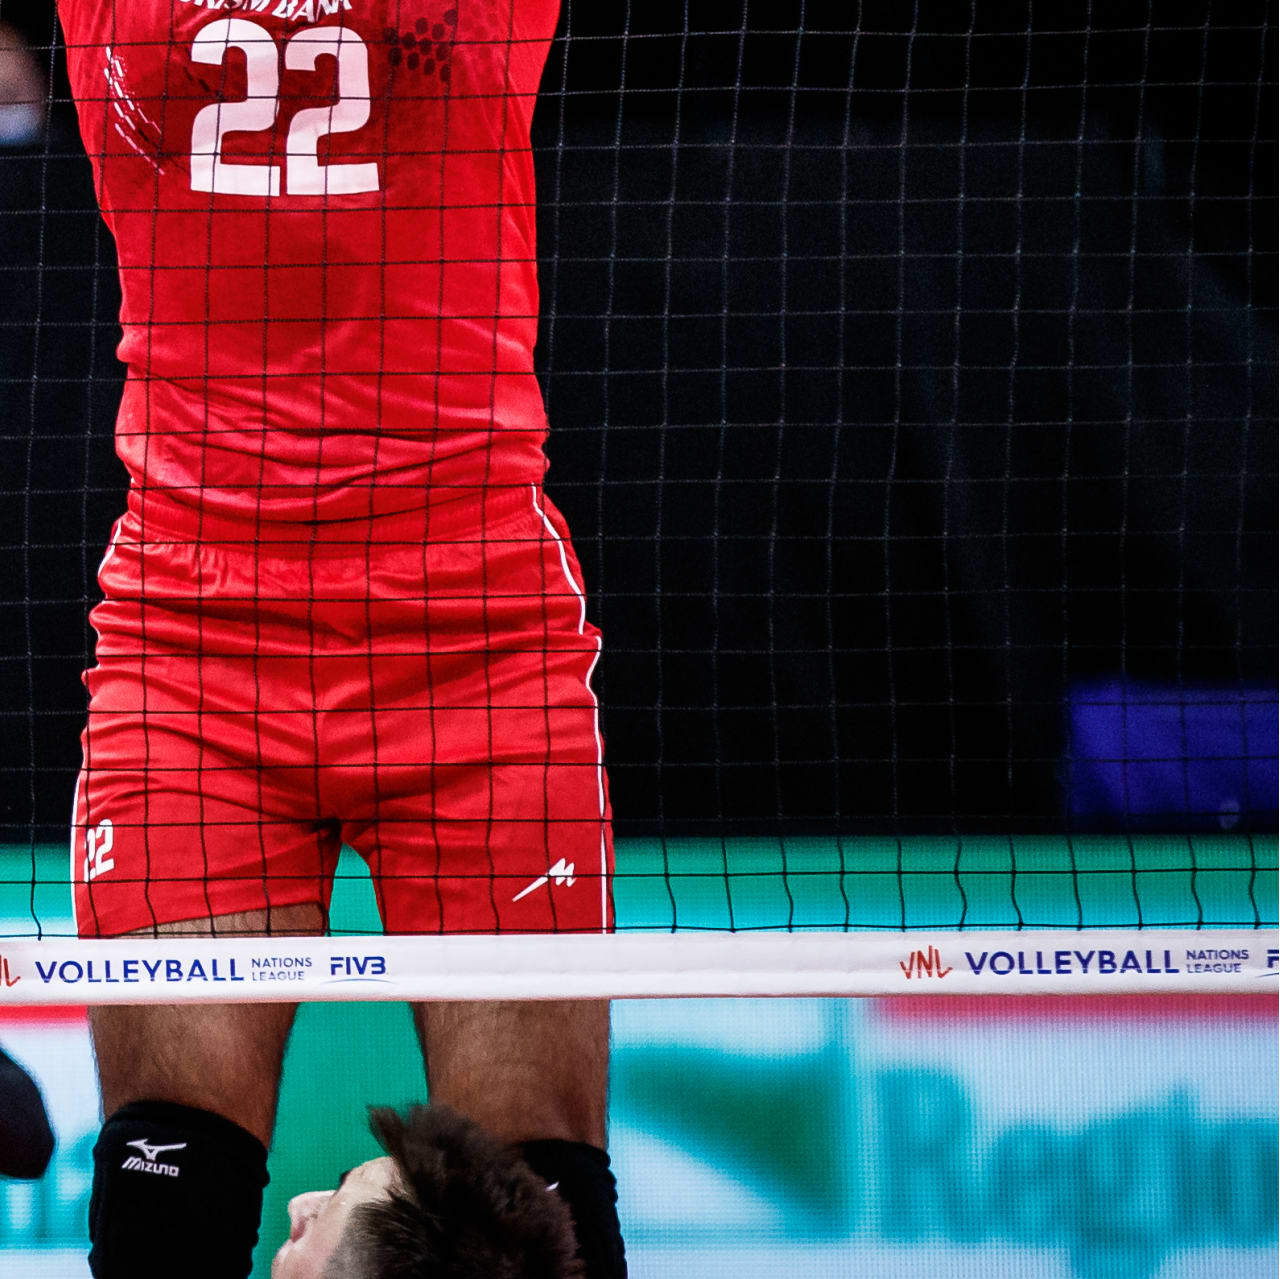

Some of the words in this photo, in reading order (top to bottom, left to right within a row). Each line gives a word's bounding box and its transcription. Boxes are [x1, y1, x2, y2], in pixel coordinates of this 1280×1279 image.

[190, 18, 380, 197] 22
[251, 956, 314, 968] NATIONS
[899, 945, 954, 981] VNL
[965, 949, 1181, 976] VOLLEYBALL
[1185, 948, 1250, 961] NATIONS
[35, 958, 246, 984] VOLLEYBALL
[329, 955, 388, 976] FIVB
[1185, 962, 1243, 975] LEAGUE
[251, 970, 306, 982] LEAGUE
